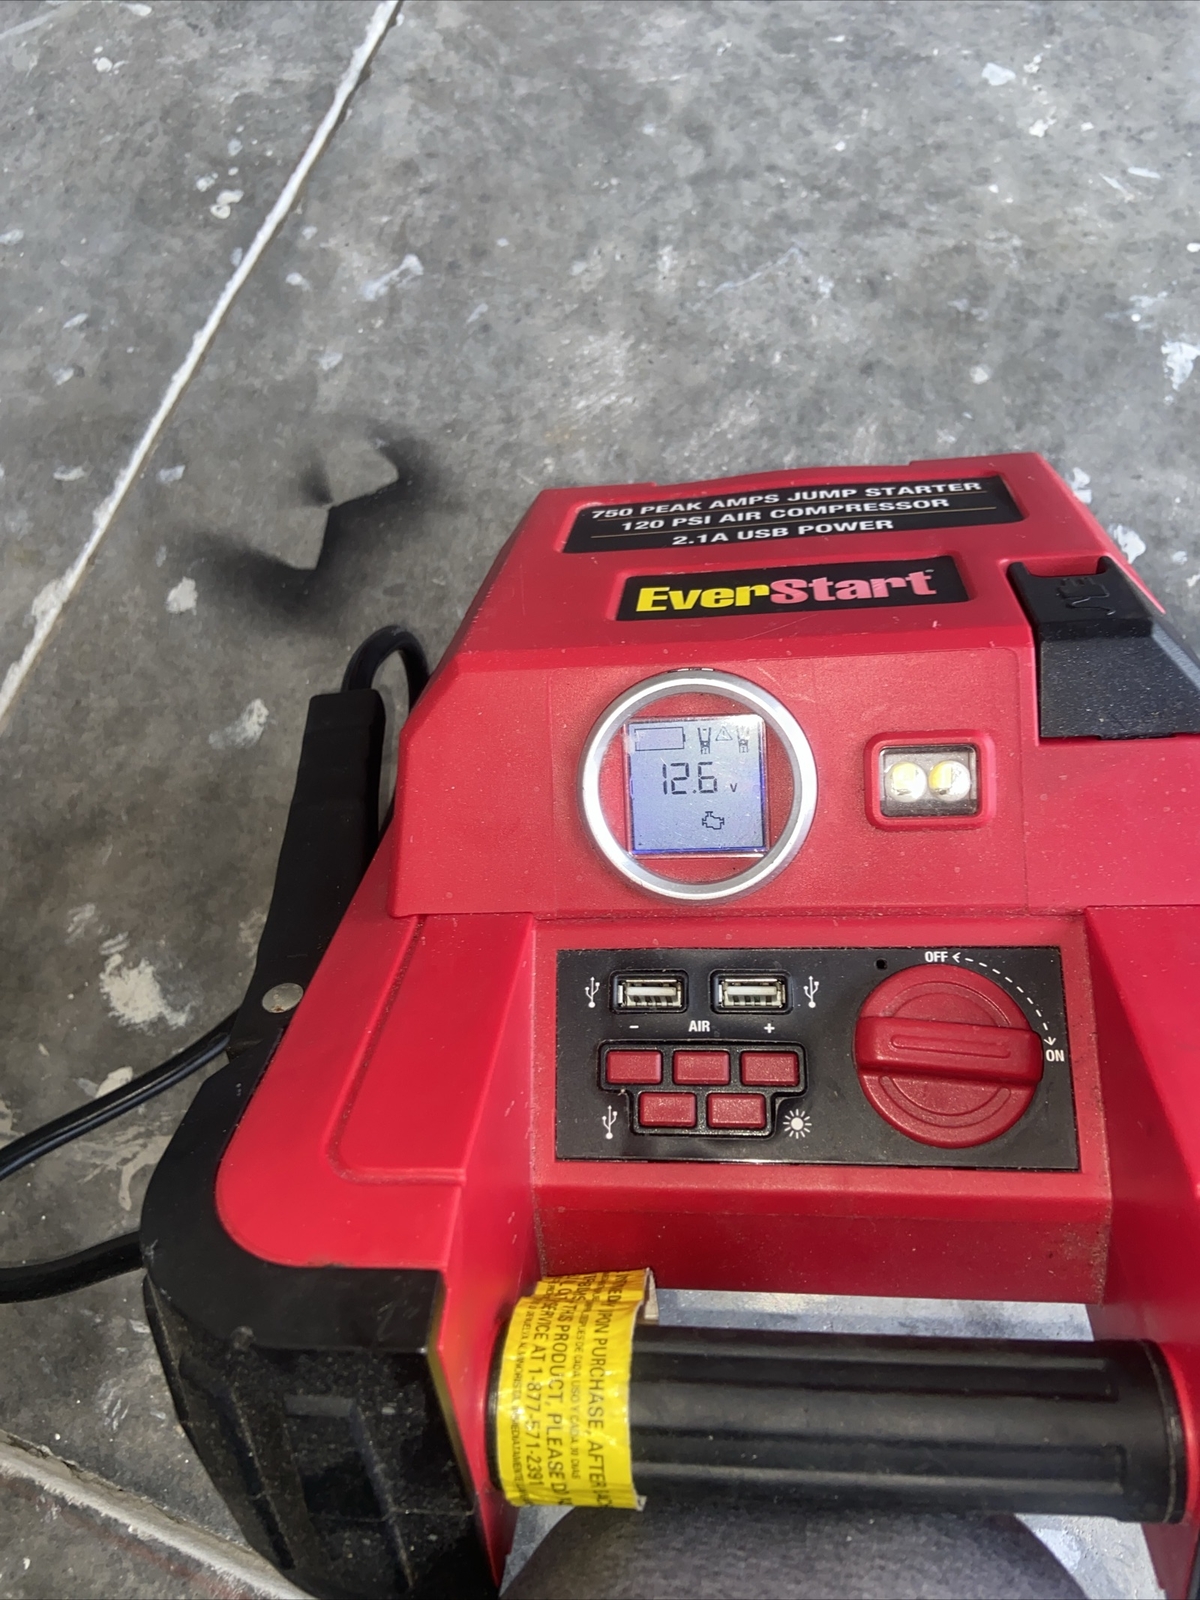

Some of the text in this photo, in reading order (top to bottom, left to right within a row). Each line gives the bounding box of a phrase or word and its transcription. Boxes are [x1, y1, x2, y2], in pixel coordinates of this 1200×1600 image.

[591, 482, 982, 519] 750 PEAK AMPS JUMP STARTER
[622, 498, 950, 531] 120 PSI AIR COMPRESSOR
[672, 519, 894, 545] 2.1A USB POWER
[636, 571, 937, 612] EverStart
[661, 761, 717, 795] 12.6
[925, 951, 949, 963] OFF
[688, 1020, 711, 1032] AIR
[1045, 1049, 1065, 1063] ON
[534, 1303, 559, 1340] SERVICE
[557, 1305, 576, 1321] THIS
[531, 1346, 547, 1362] AT
[546, 1325, 570, 1406] PRODUCT,
[586, 1338, 608, 1435] PURCHASE,
[525, 1367, 544, 1486] 1-877-571-2391
[547, 1414, 565, 1478] PLEASE
[588, 1440, 606, 1487] AFTER
